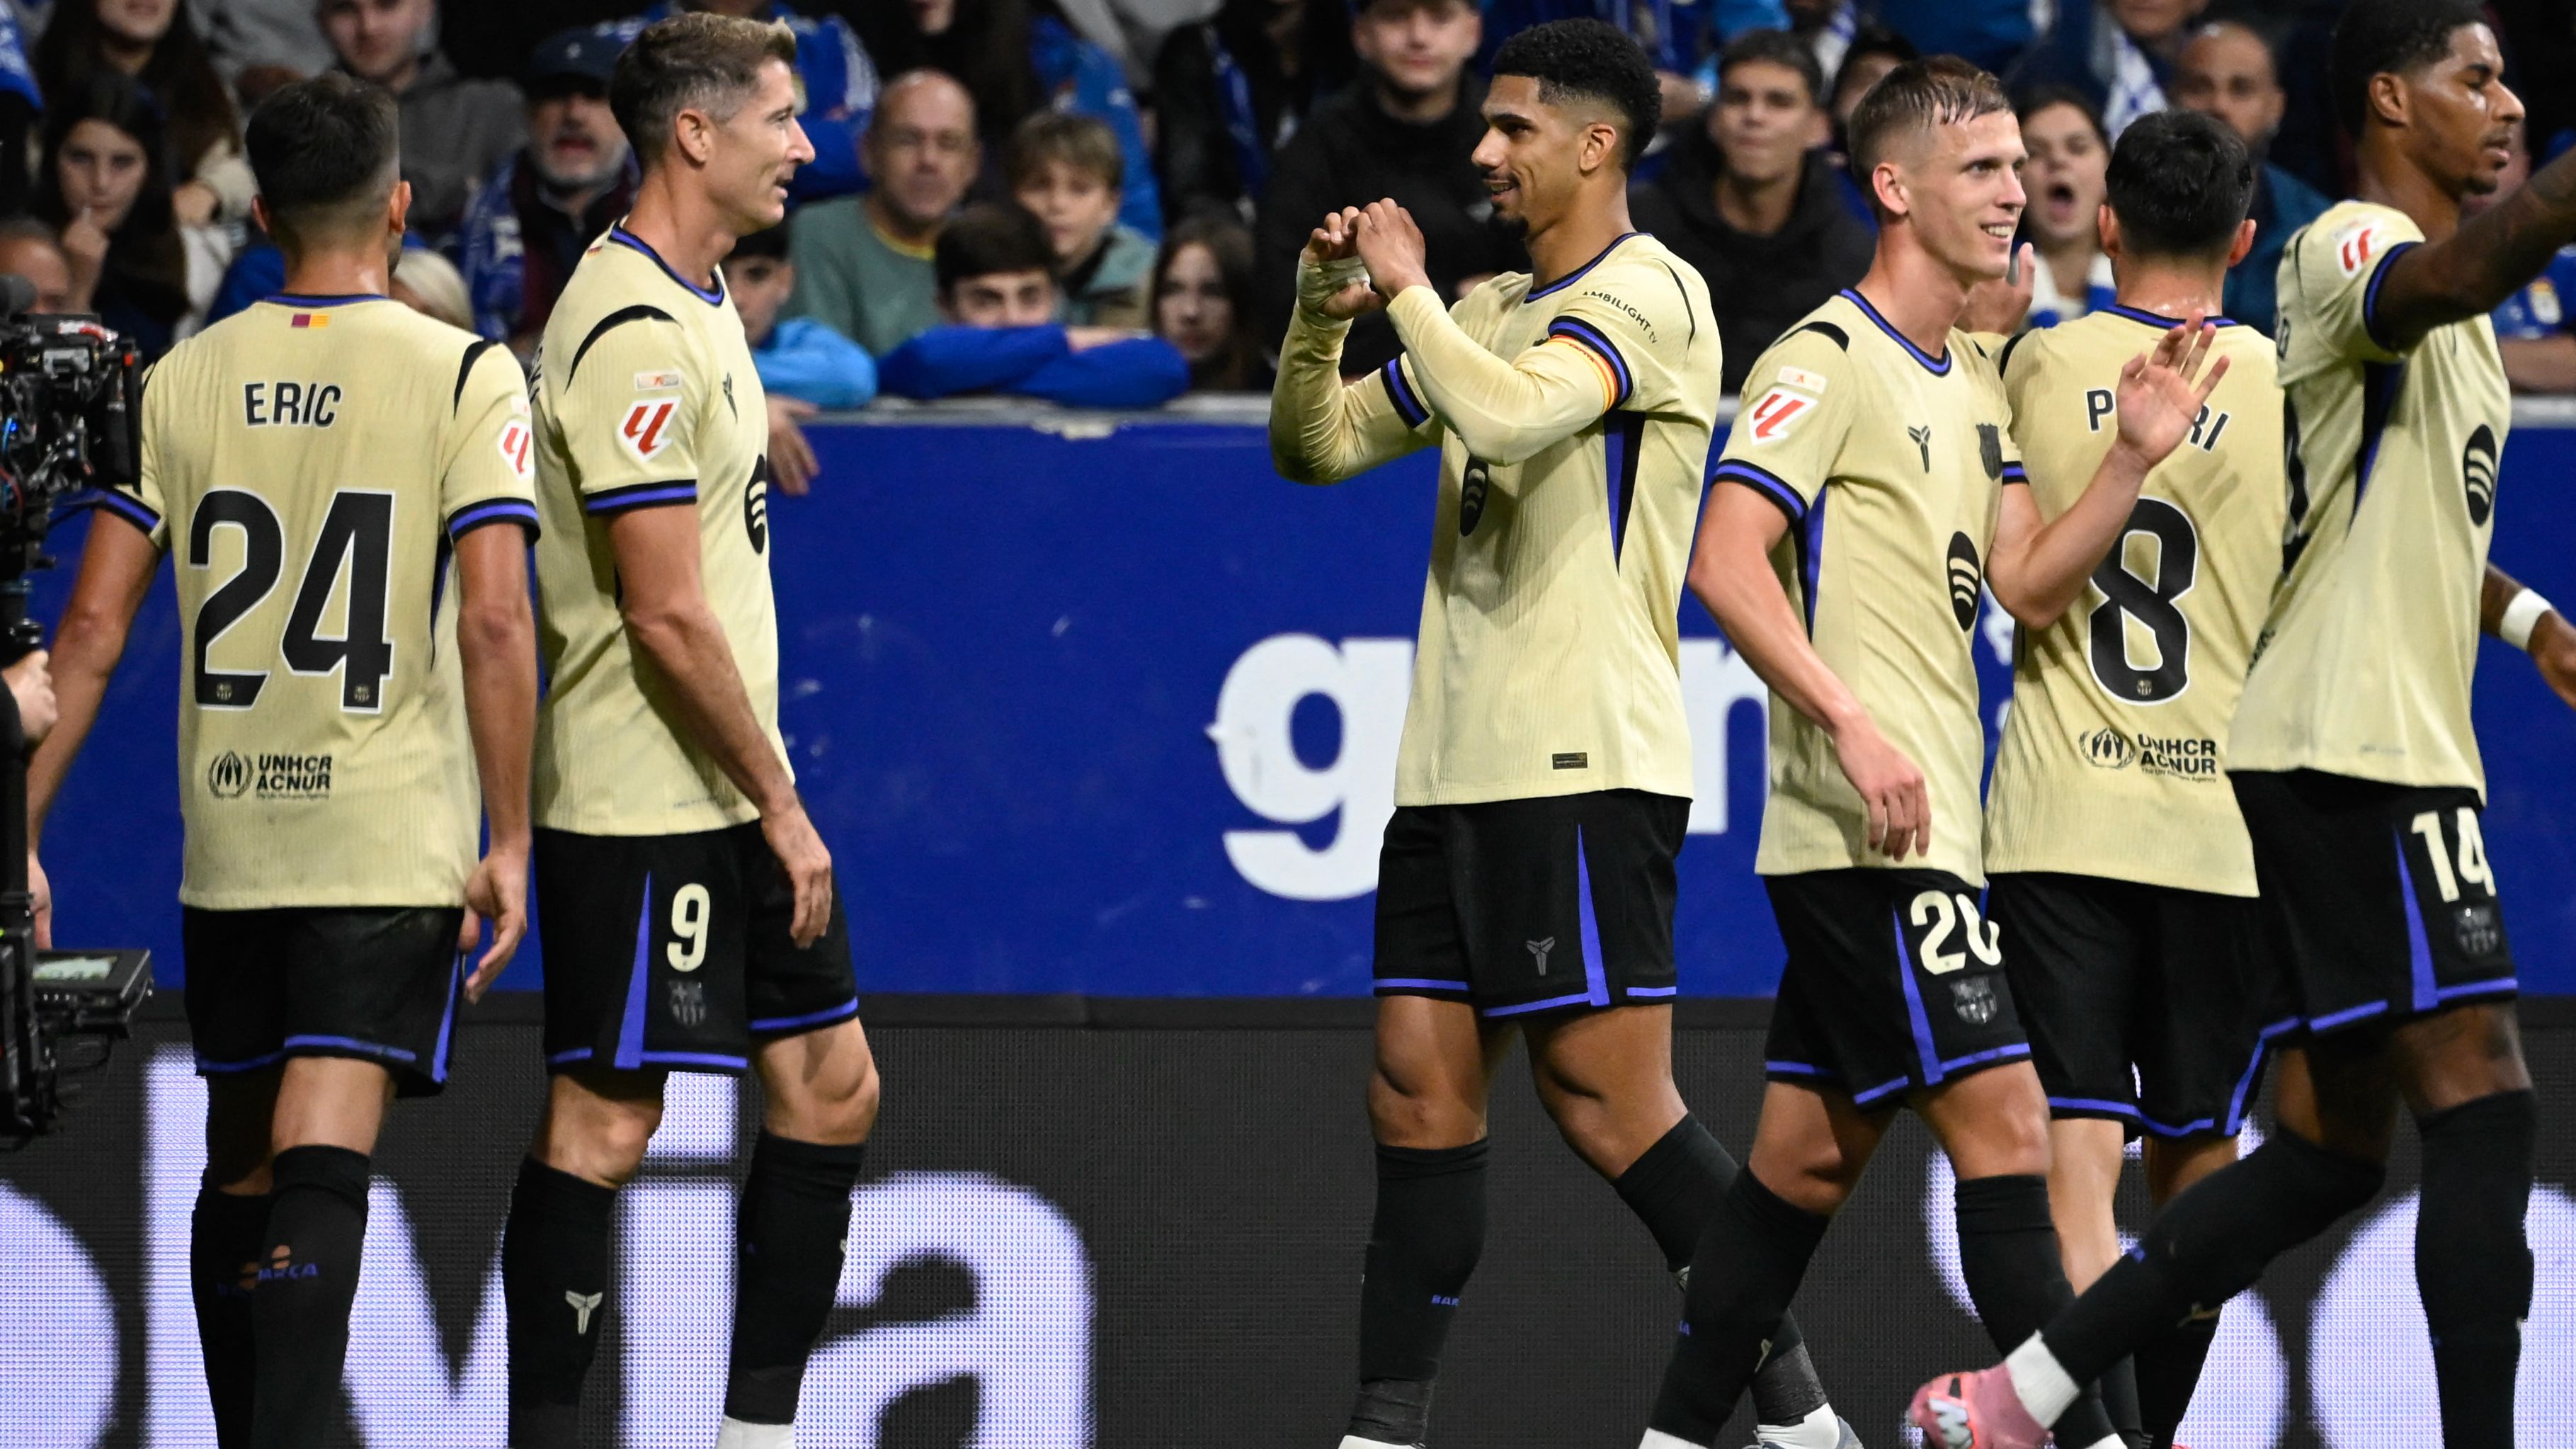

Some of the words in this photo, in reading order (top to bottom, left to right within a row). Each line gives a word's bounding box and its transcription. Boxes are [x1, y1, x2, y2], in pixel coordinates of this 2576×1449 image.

[244, 382, 342, 427] ERIC
[2085, 389, 2230, 453] PRI
[189, 487, 395, 713] 24
[2090, 494, 2199, 706] 8
[258, 754, 332, 772] UNHCR
[2137, 733, 2216, 756] UNHCR
[2141, 750, 2216, 775] ACNUR
[256, 773, 331, 791] ACNUR
[2411, 807, 2497, 903] 14
[667, 883, 710, 972] 9
[1910, 890, 2002, 975] 20
